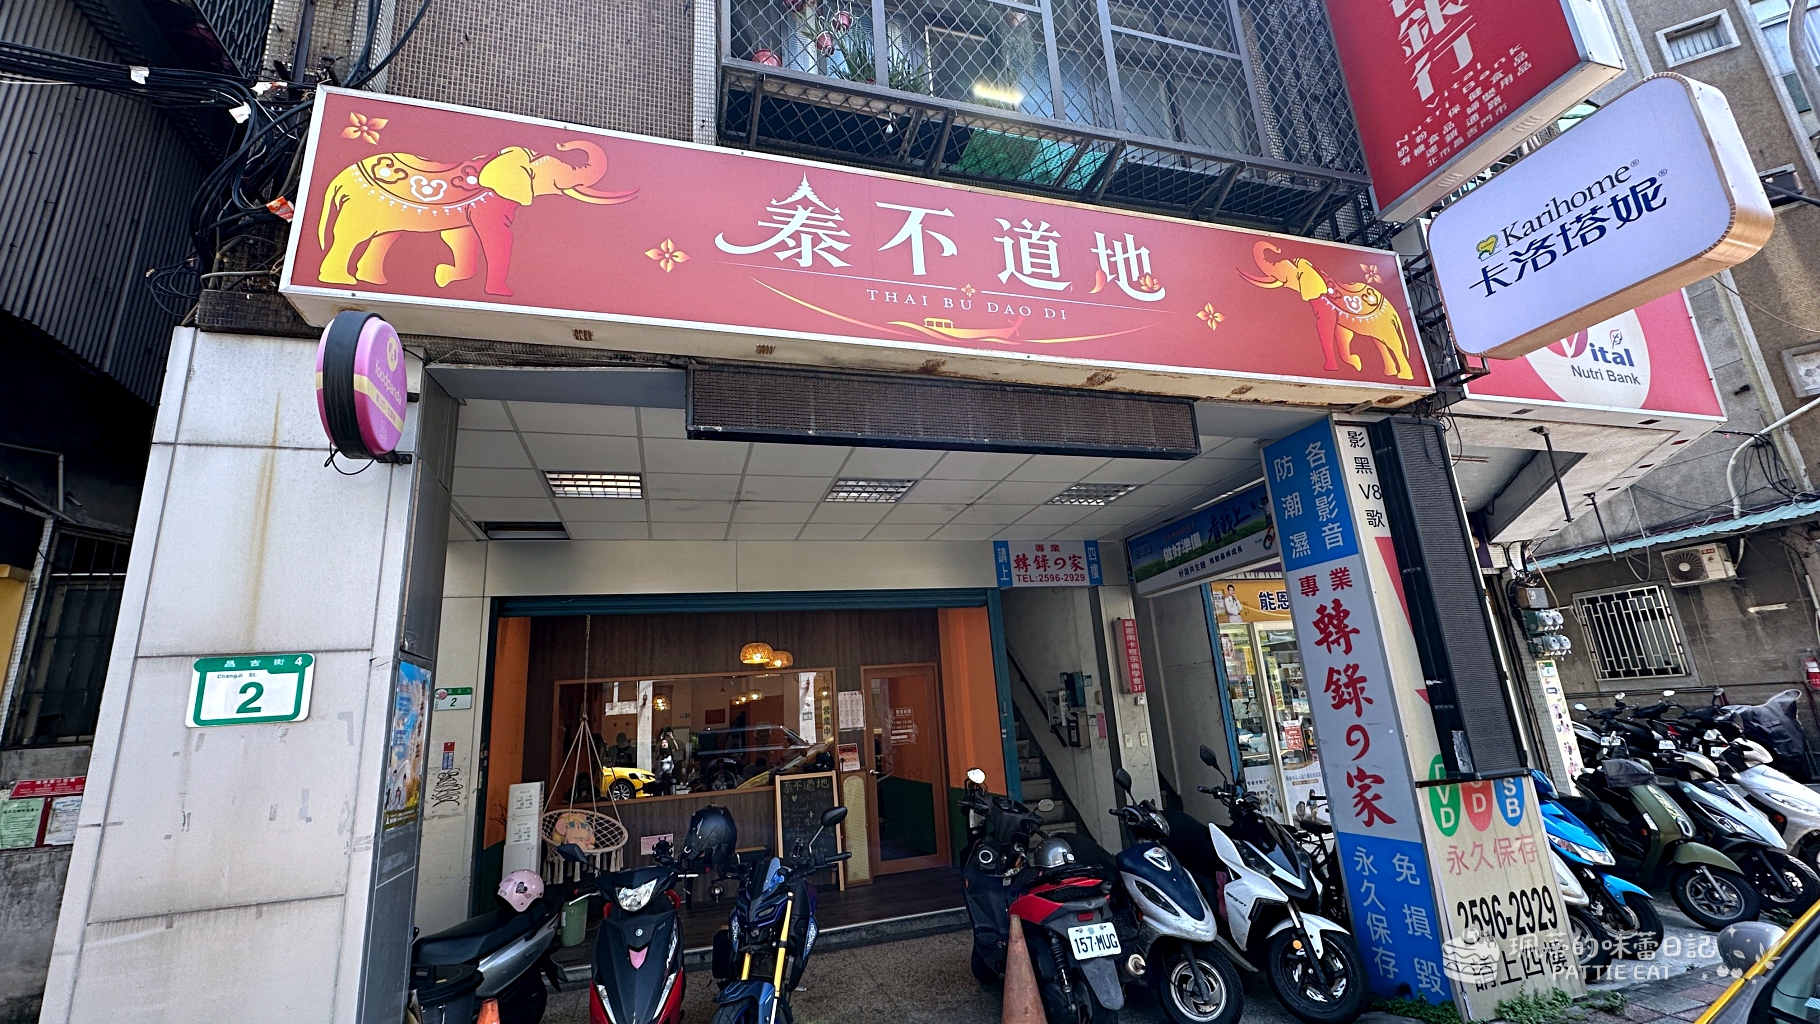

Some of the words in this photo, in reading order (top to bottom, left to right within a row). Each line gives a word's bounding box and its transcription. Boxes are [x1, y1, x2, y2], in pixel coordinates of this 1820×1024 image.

[1388, 0, 1477, 101] 銀行
[1396, 100, 1450, 147] Nutri
[1462, 44, 1522, 94] Bank
[1426, 62, 1482, 107] Vital
[1447, 51, 1529, 118] 保健食品
[1466, 60, 1532, 115] 婦嬰用品
[1501, 164, 1632, 248] Karihome
[714, 172, 1166, 302] 泰不道地
[1469, 176, 1667, 298] 卡洛塔妮
[867, 289, 930, 308] THAI
[943, 297, 973, 311] BU
[987, 300, 1032, 317] DAO
[1045, 308, 1068, 321] DI
[375, 359, 402, 406] foodpanda
[1570, 365, 1604, 381] Nutri
[1606, 369, 1641, 386] Bank
[1304, 441, 1344, 550] 各類影音
[997, 547, 1010, 581] 請上
[1035, 544, 1061, 553] 專業
[1087, 546, 1100, 579] 四樓
[1016, 573, 1086, 583] TEL:2596-2929
[1299, 566, 1353, 597] 專業
[223, 658, 285, 668] 昌吉街
[294, 656, 303, 666] 4
[235, 681, 264, 714] 2
[449, 697, 457, 707] 2
[1502, 776, 1521, 819] SB
[1446, 834, 1537, 876] 永久保存
[1354, 846, 1399, 980] 永久保存
[1392, 852, 1445, 997] 免損毀
[1457, 885, 1558, 940] 2596-2929
